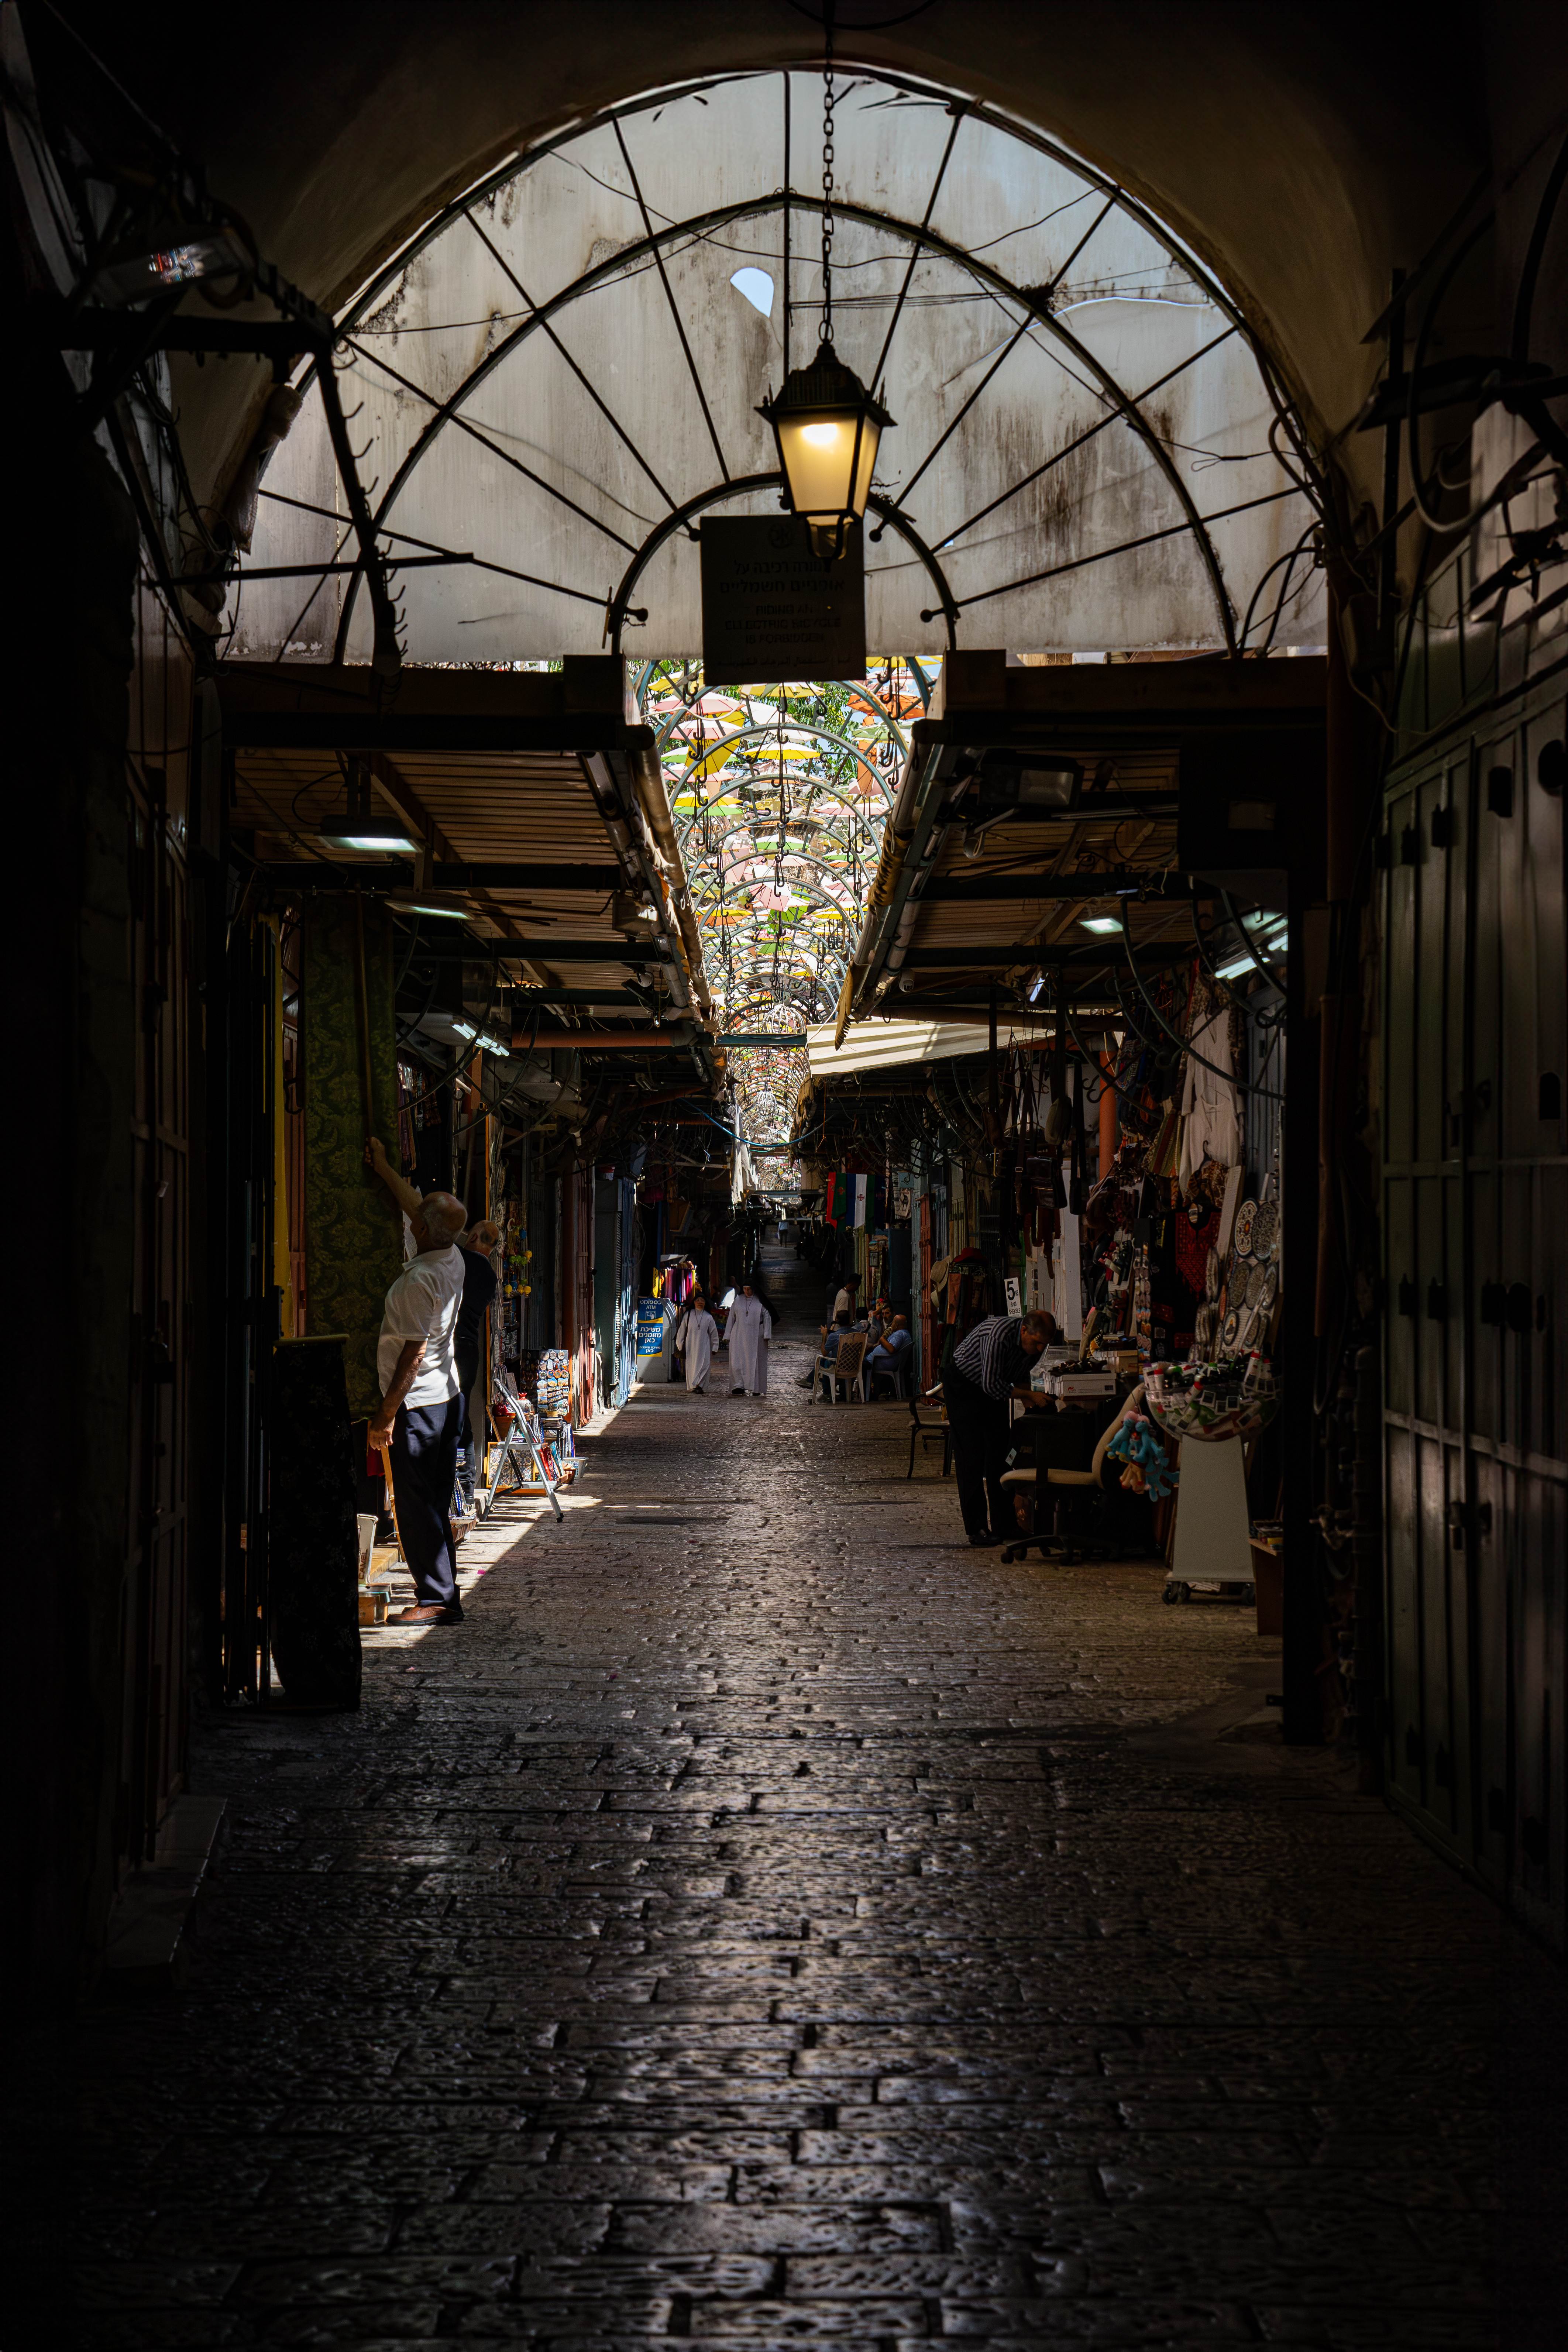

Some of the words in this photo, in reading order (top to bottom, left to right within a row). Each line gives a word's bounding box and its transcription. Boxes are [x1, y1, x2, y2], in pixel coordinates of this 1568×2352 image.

[734, 560, 750, 575] על
[754, 561, 788, 573] רכיבה
[792, 561, 822, 572] סורה
[720, 579, 785, 593] חשמליים
[790, 579, 845, 591] אופניים
[756, 604, 794, 616] RIDING
[1007, 1280, 1015, 1300] 5
[358, 1549, 368, 1579] CAMEL
